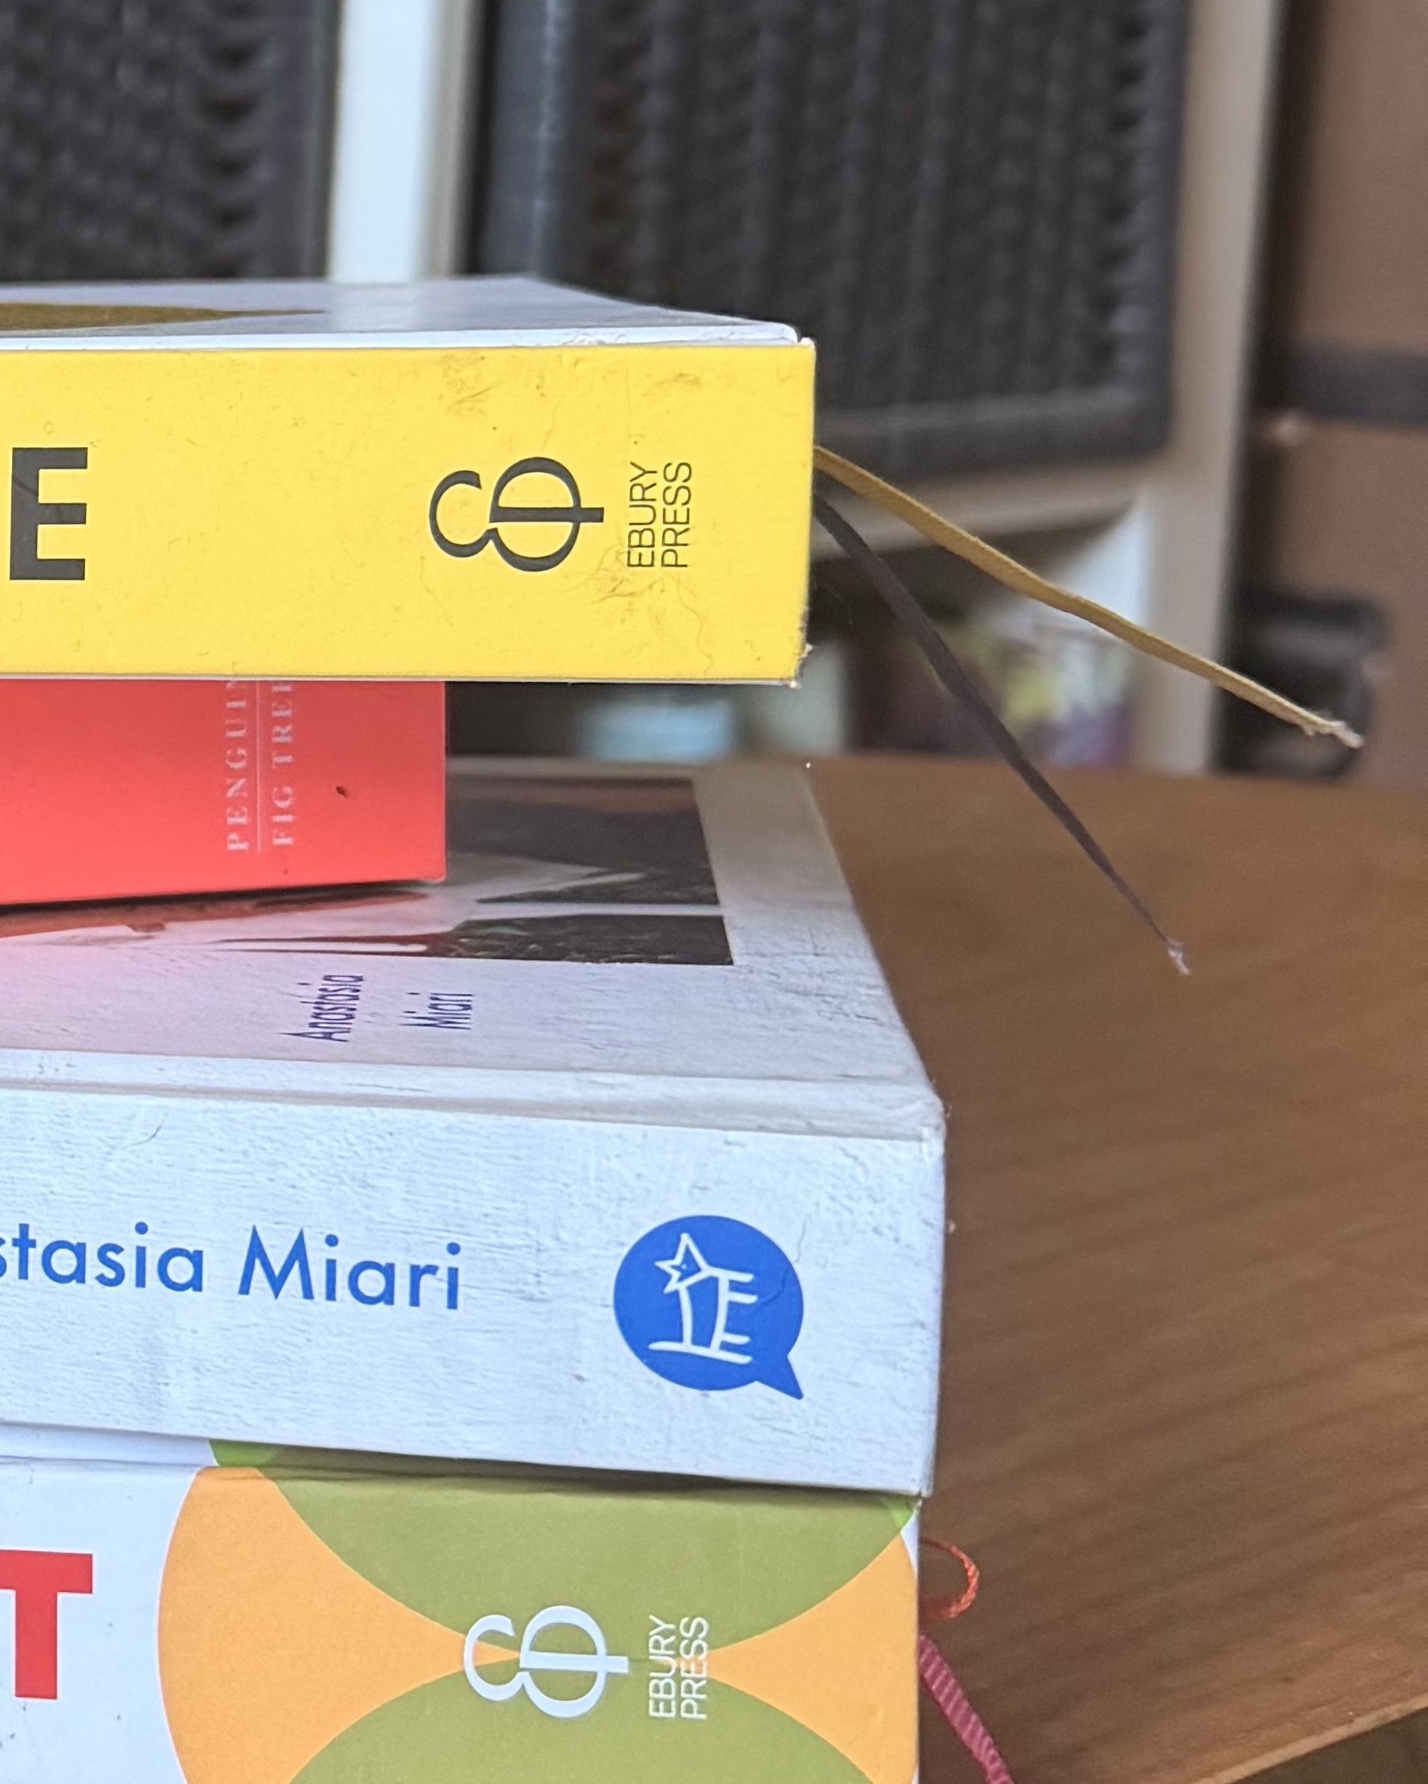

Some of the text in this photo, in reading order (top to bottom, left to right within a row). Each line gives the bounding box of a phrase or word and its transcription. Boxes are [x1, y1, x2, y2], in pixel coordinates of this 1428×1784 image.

[626, 460, 658, 569] EBURY
[660, 460, 693, 569] PRESS
[271, 785, 294, 846] FIG
[278, 973, 365, 1043] Anastasia
[398, 990, 474, 1031] Miari
[236, 1224, 462, 1311] Miari
[648, 1614, 678, 1719] EBURY
[679, 1615, 710, 1721] PRESS
